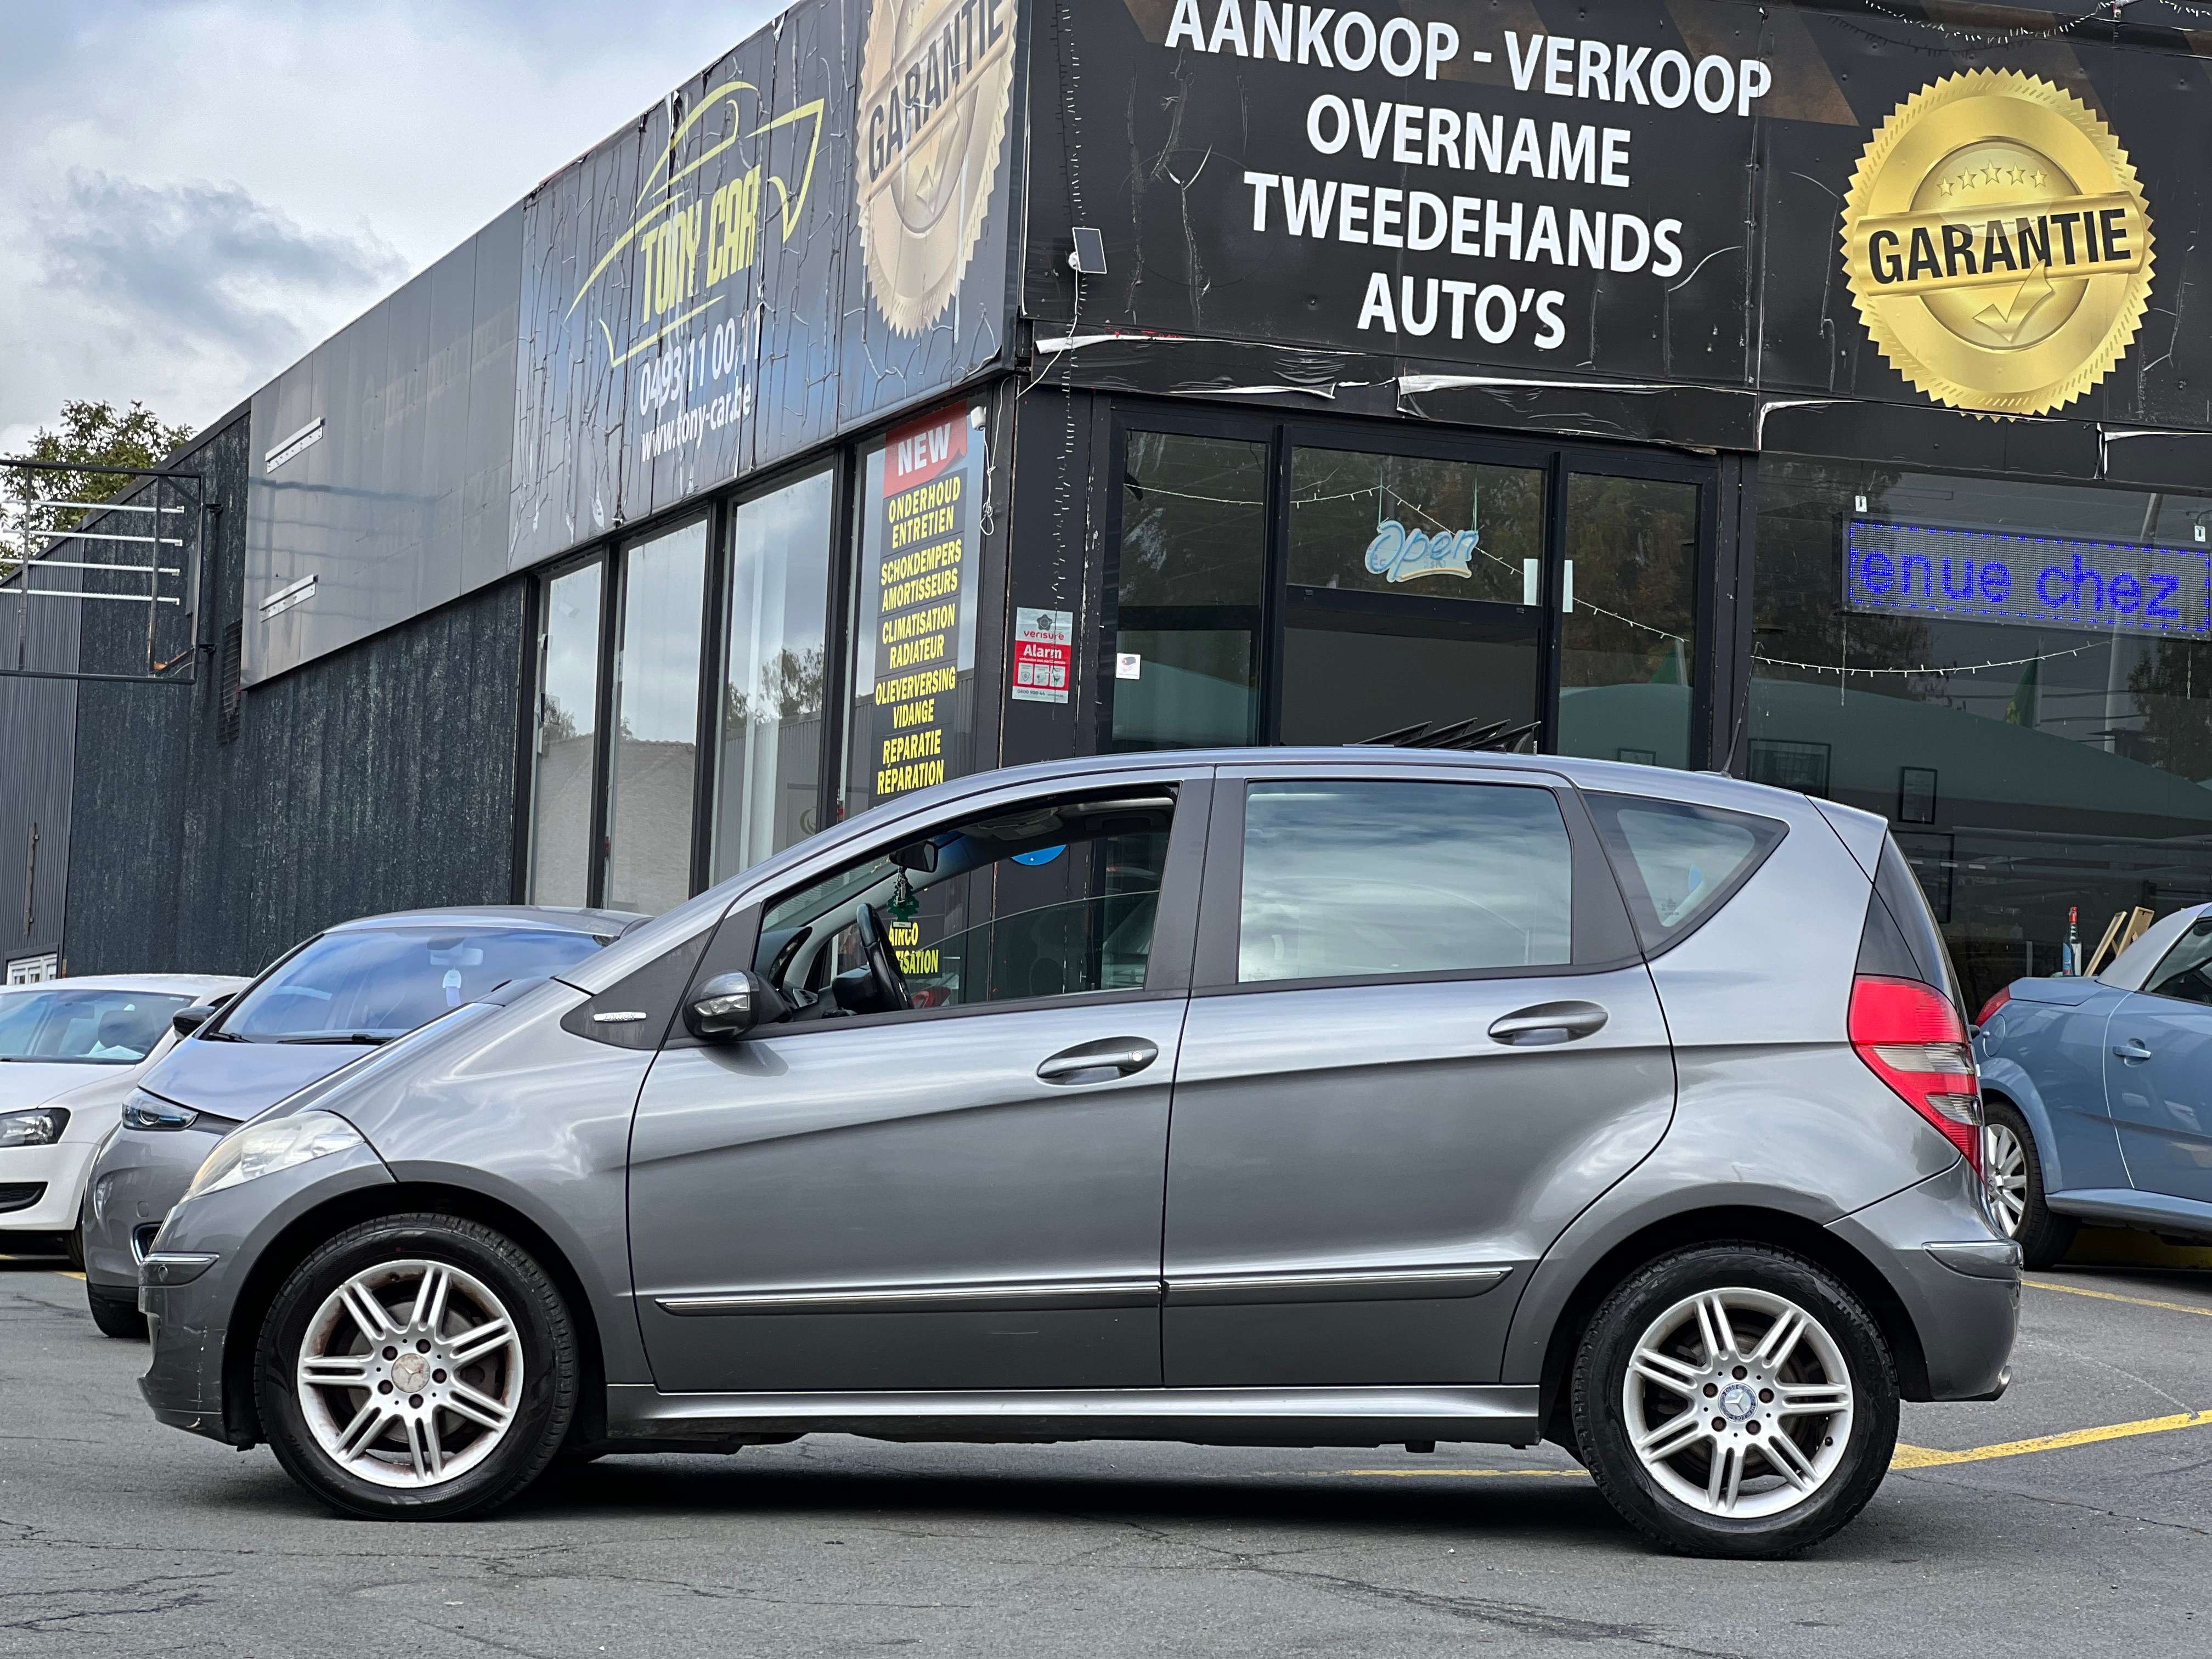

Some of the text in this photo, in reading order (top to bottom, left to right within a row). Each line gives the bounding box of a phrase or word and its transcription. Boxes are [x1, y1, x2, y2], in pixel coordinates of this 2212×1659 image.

[1165, 0, 1460, 81] AANKOOP
[1504, 31, 1772, 117] VERKOOP
[868, 0, 1003, 182] GARANTIE
[1307, 94, 1631, 188] OVERNAME
[641, 164, 760, 324] TONY CAR
[1244, 171, 1683, 278] TWEEDEHANDS
[1868, 208, 2132, 284] GARANTIE
[1357, 272, 1566, 349] AUTO'S
[896, 423, 951, 477] NEW
[889, 476, 961, 523] ONDERHOUD
[892, 506, 954, 549] ENTRETIEN
[881, 539, 962, 586] SCHOKDEMPERS
[1370, 523, 1478, 580] Open
[882, 568, 958, 612] AMORTISSEURS
[2035, 552, 2180, 619] chez
[882, 603, 956, 645] CLIMATISATION
[889, 634, 945, 669] RADIATEUR
[1024, 645, 1062, 659] Alarm
[875, 666, 956, 706] OLIEVERVERSING
[893, 698, 935, 729] VIDANGE
[883, 729, 941, 765] REPARATIE
[877, 759, 944, 795] RÉPARATION
